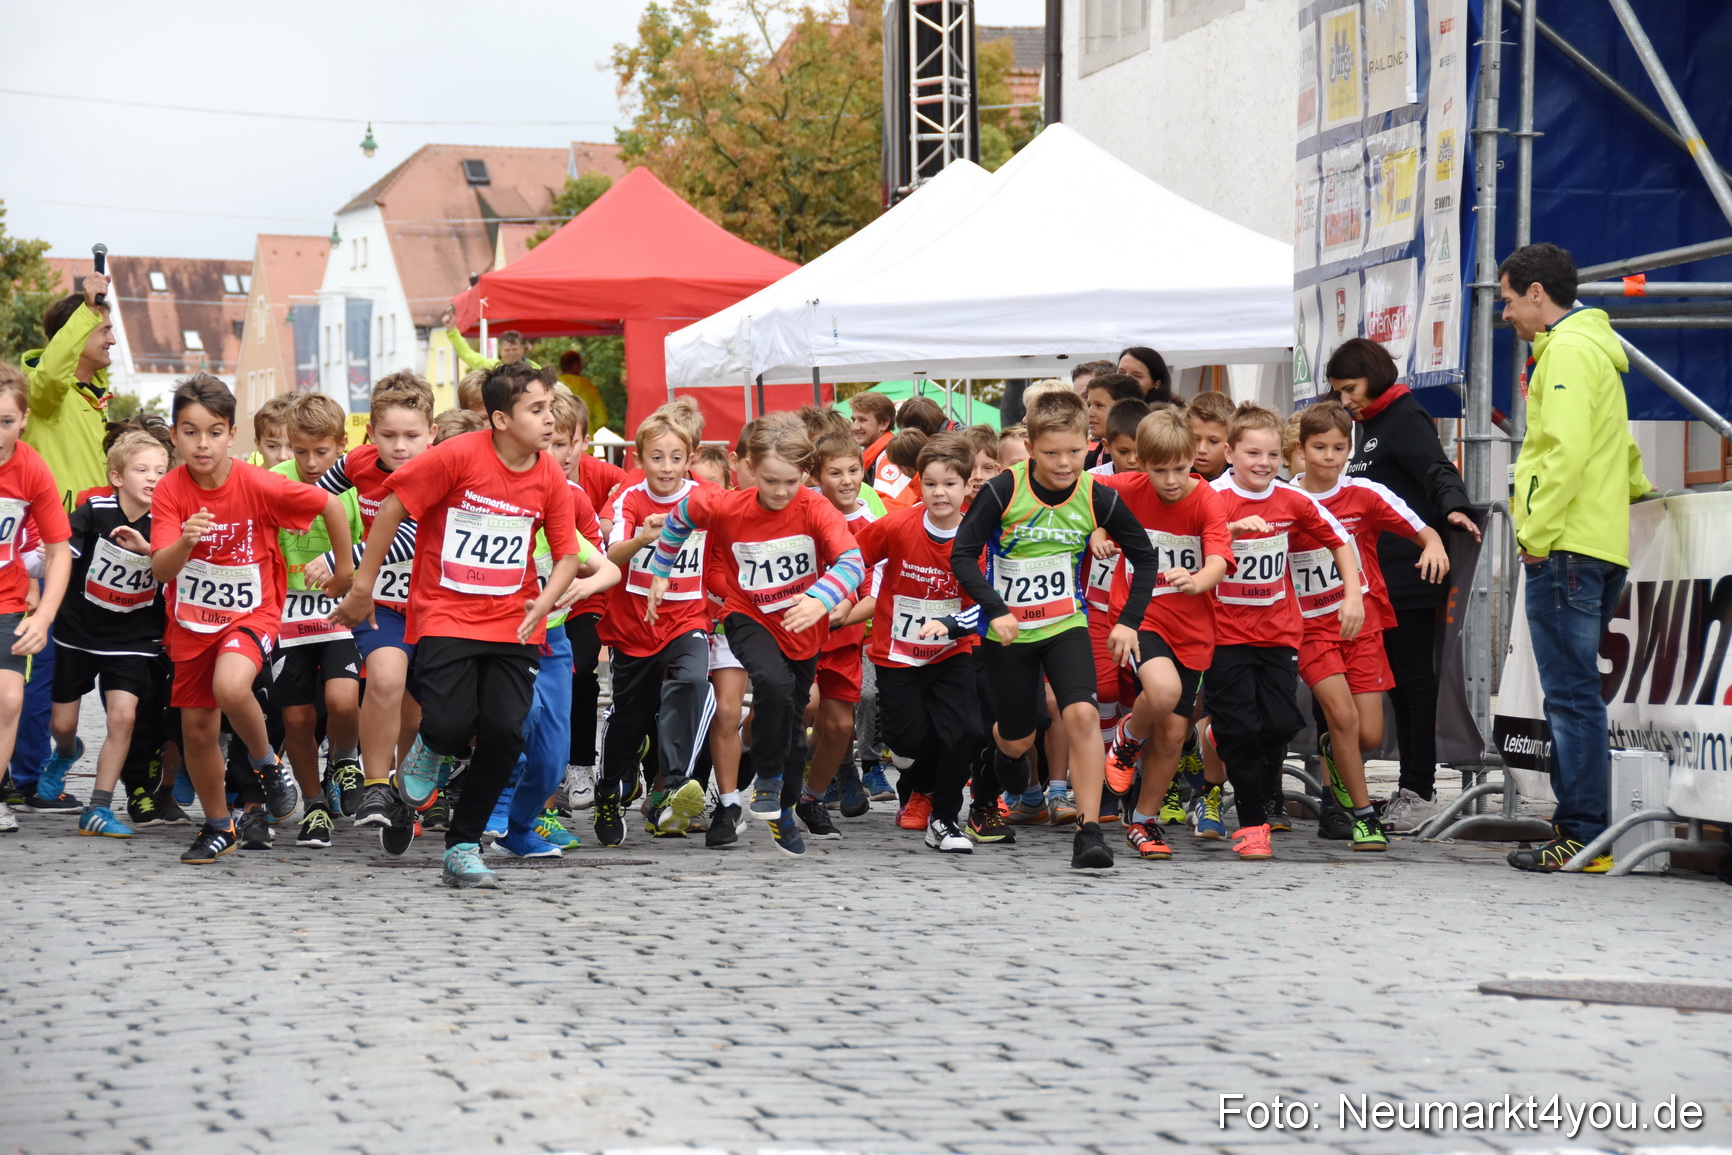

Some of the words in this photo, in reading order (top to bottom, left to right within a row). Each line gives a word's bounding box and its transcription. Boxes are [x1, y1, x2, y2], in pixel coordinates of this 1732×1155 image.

[1369, 51, 1403, 74] RAIL.ONE
[465, 490, 520, 513] Neumarkter
[487, 518, 525, 528] BOCK
[1014, 525, 1082, 544] BOCK
[455, 529, 523, 565] 7422
[766, 539, 805, 551] BOCK
[641, 546, 699, 573] 744
[744, 553, 809, 586] 7138
[1025, 557, 1063, 571] BOCK
[1155, 547, 1195, 571] 16
[97, 557, 152, 590] 7243
[212, 567, 253, 577] BOCK
[467, 569, 485, 581] Ali
[1297, 560, 1342, 592] 714
[109, 592, 134, 605] Leon
[185, 575, 254, 609] 7235
[753, 583, 805, 604] Alexander
[1001, 571, 1065, 603] 7239
[1242, 584, 1271, 596] Lukas
[201, 610, 233, 624] Lukas
[287, 594, 344, 618] 706
[1022, 608, 1045, 619] Joel
[1598, 575, 1732, 706] swn
[1608, 720, 1675, 766] dtwerke
